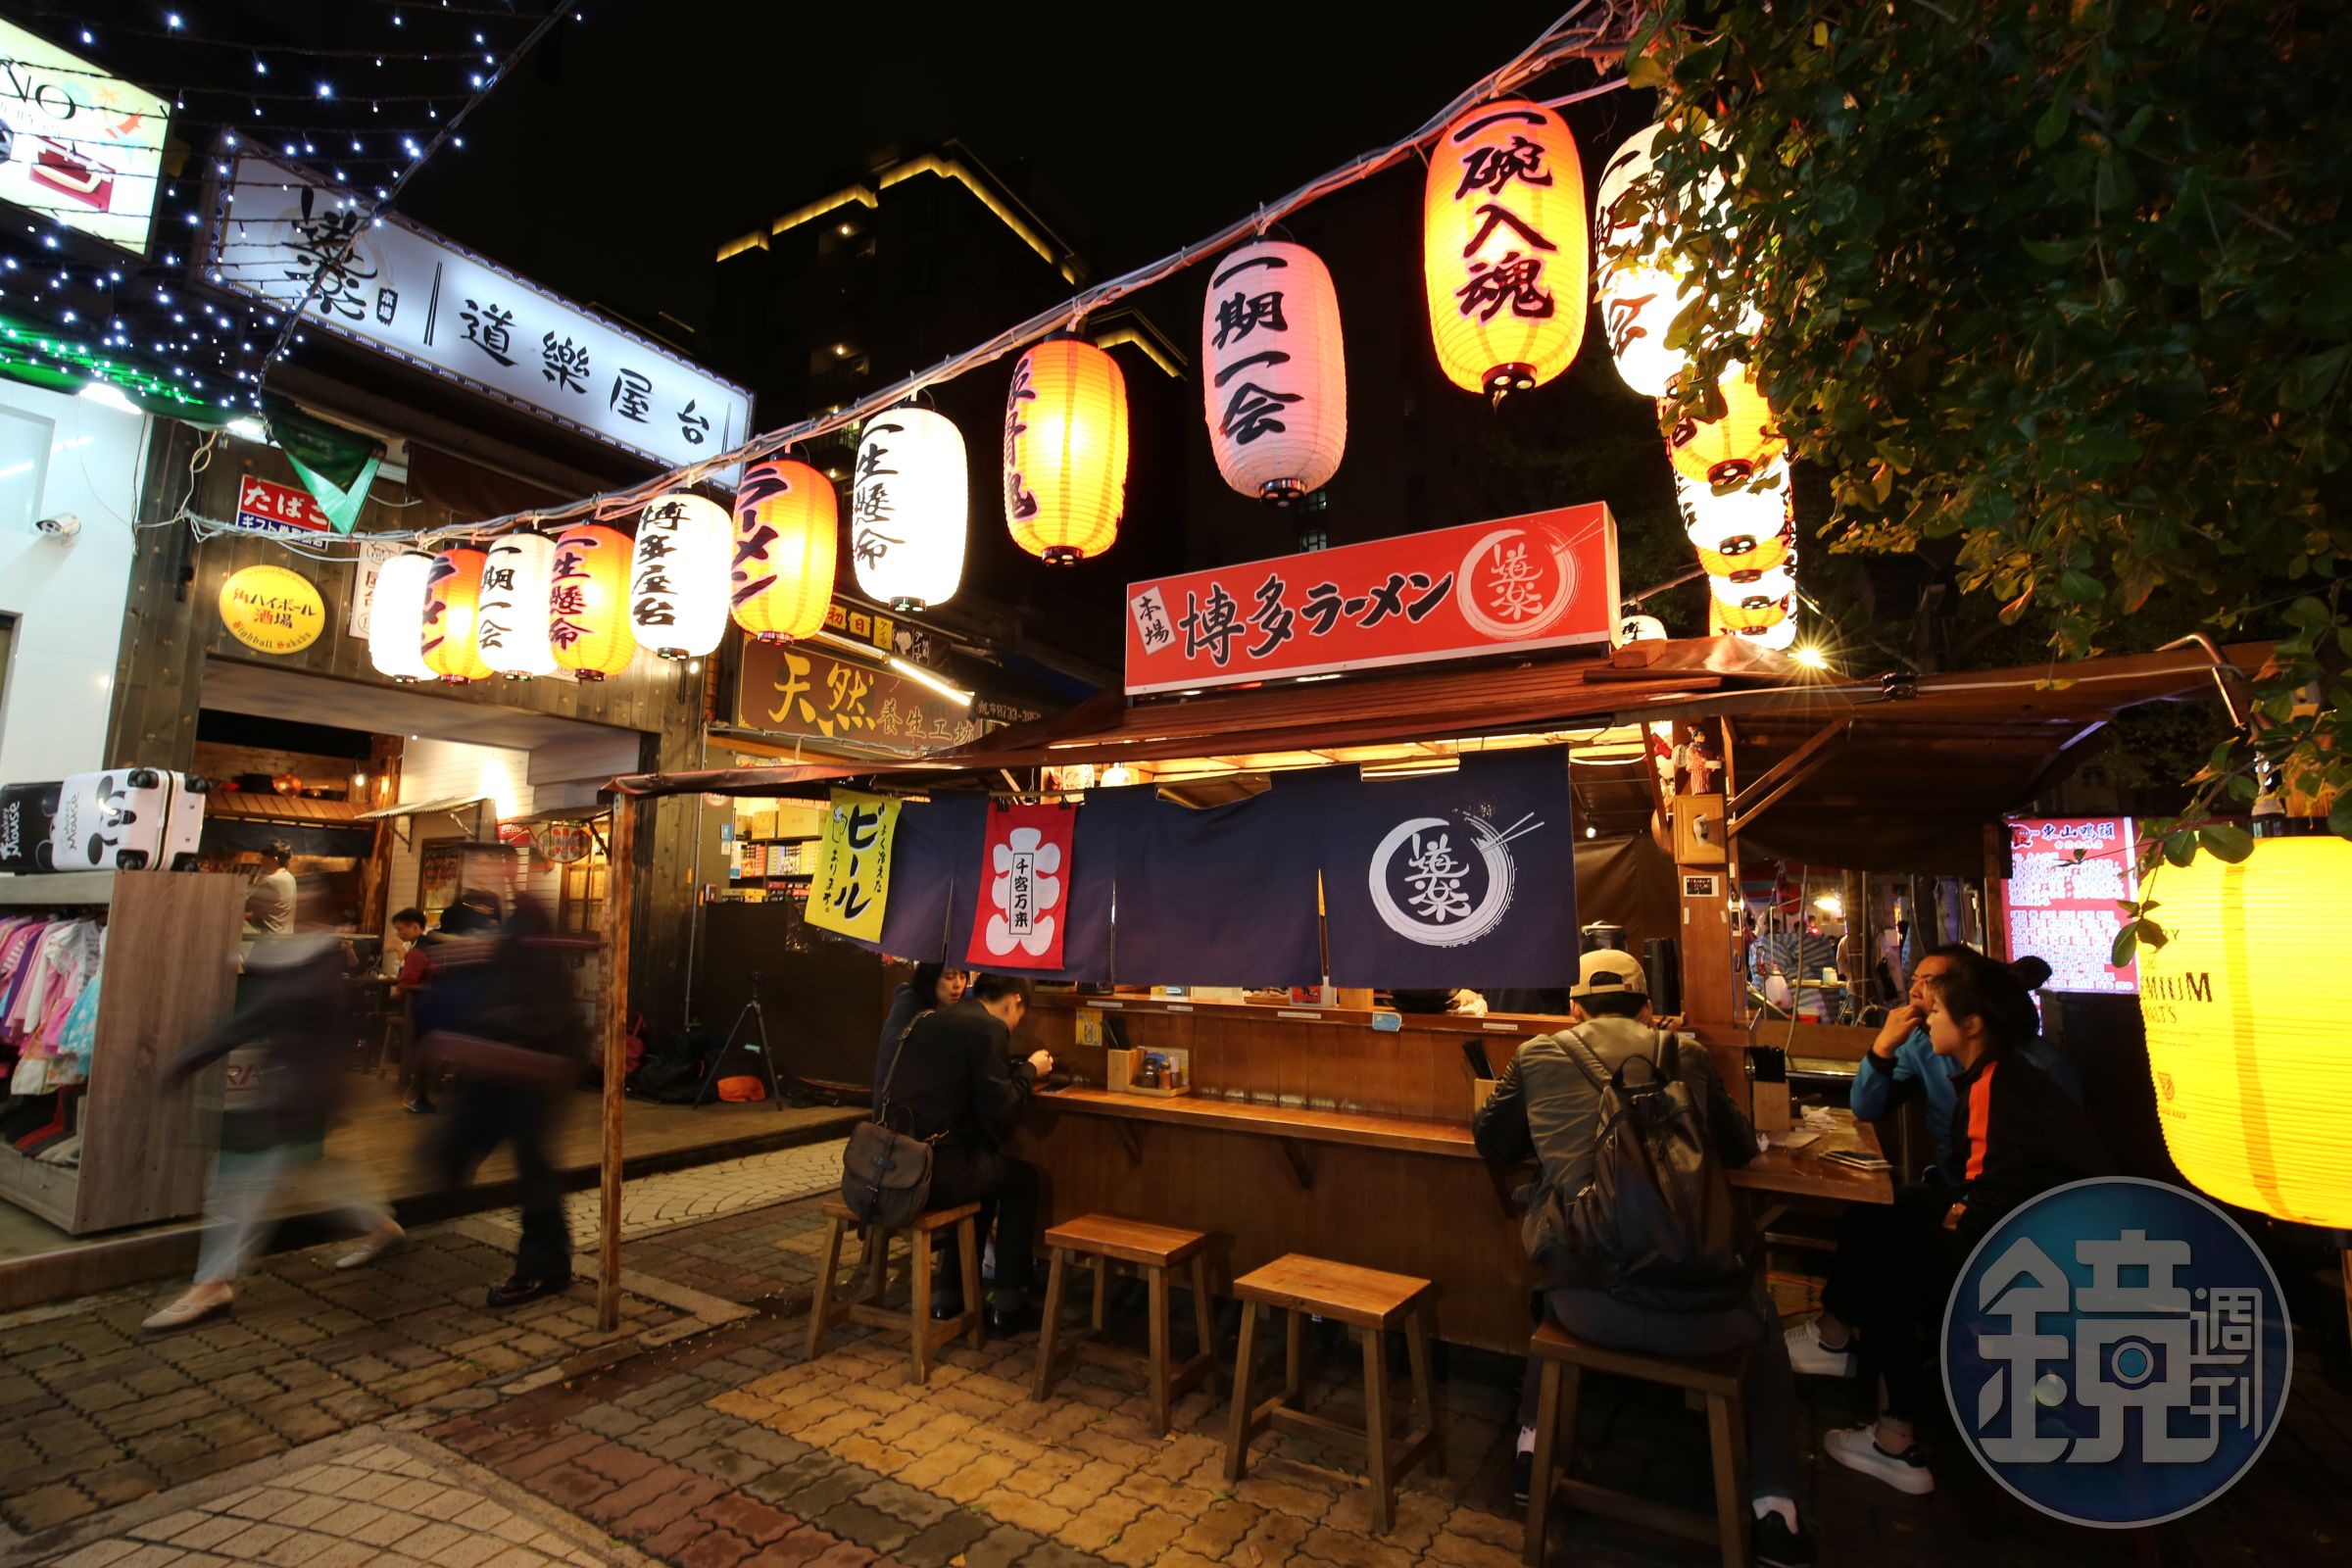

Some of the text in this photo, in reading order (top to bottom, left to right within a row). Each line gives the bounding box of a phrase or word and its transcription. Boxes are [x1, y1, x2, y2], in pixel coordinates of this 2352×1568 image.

[1454, 111, 1557, 322] 一碗入魂
[459, 299, 710, 445] 道樂屋台
[1212, 256, 1304, 445] 一期一会
[244, 485, 328, 525] たばこ
[731, 467, 788, 609] ラーメン
[855, 422, 906, 570] 一生懸命
[478, 546, 521, 650] 一期一会
[549, 538, 599, 651] 一生懸命
[632, 501, 689, 626] 博多屋台
[253, 608, 293, 629] 酒場
[1140, 596, 1169, 646] 本場
[1178, 571, 1454, 666] 博多ラーメン
[768, 652, 877, 737] 天然
[877, 698, 975, 745] 養生工坊
[834, 803, 885, 919] ビール
[1013, 858, 1029, 929] 千客万来
